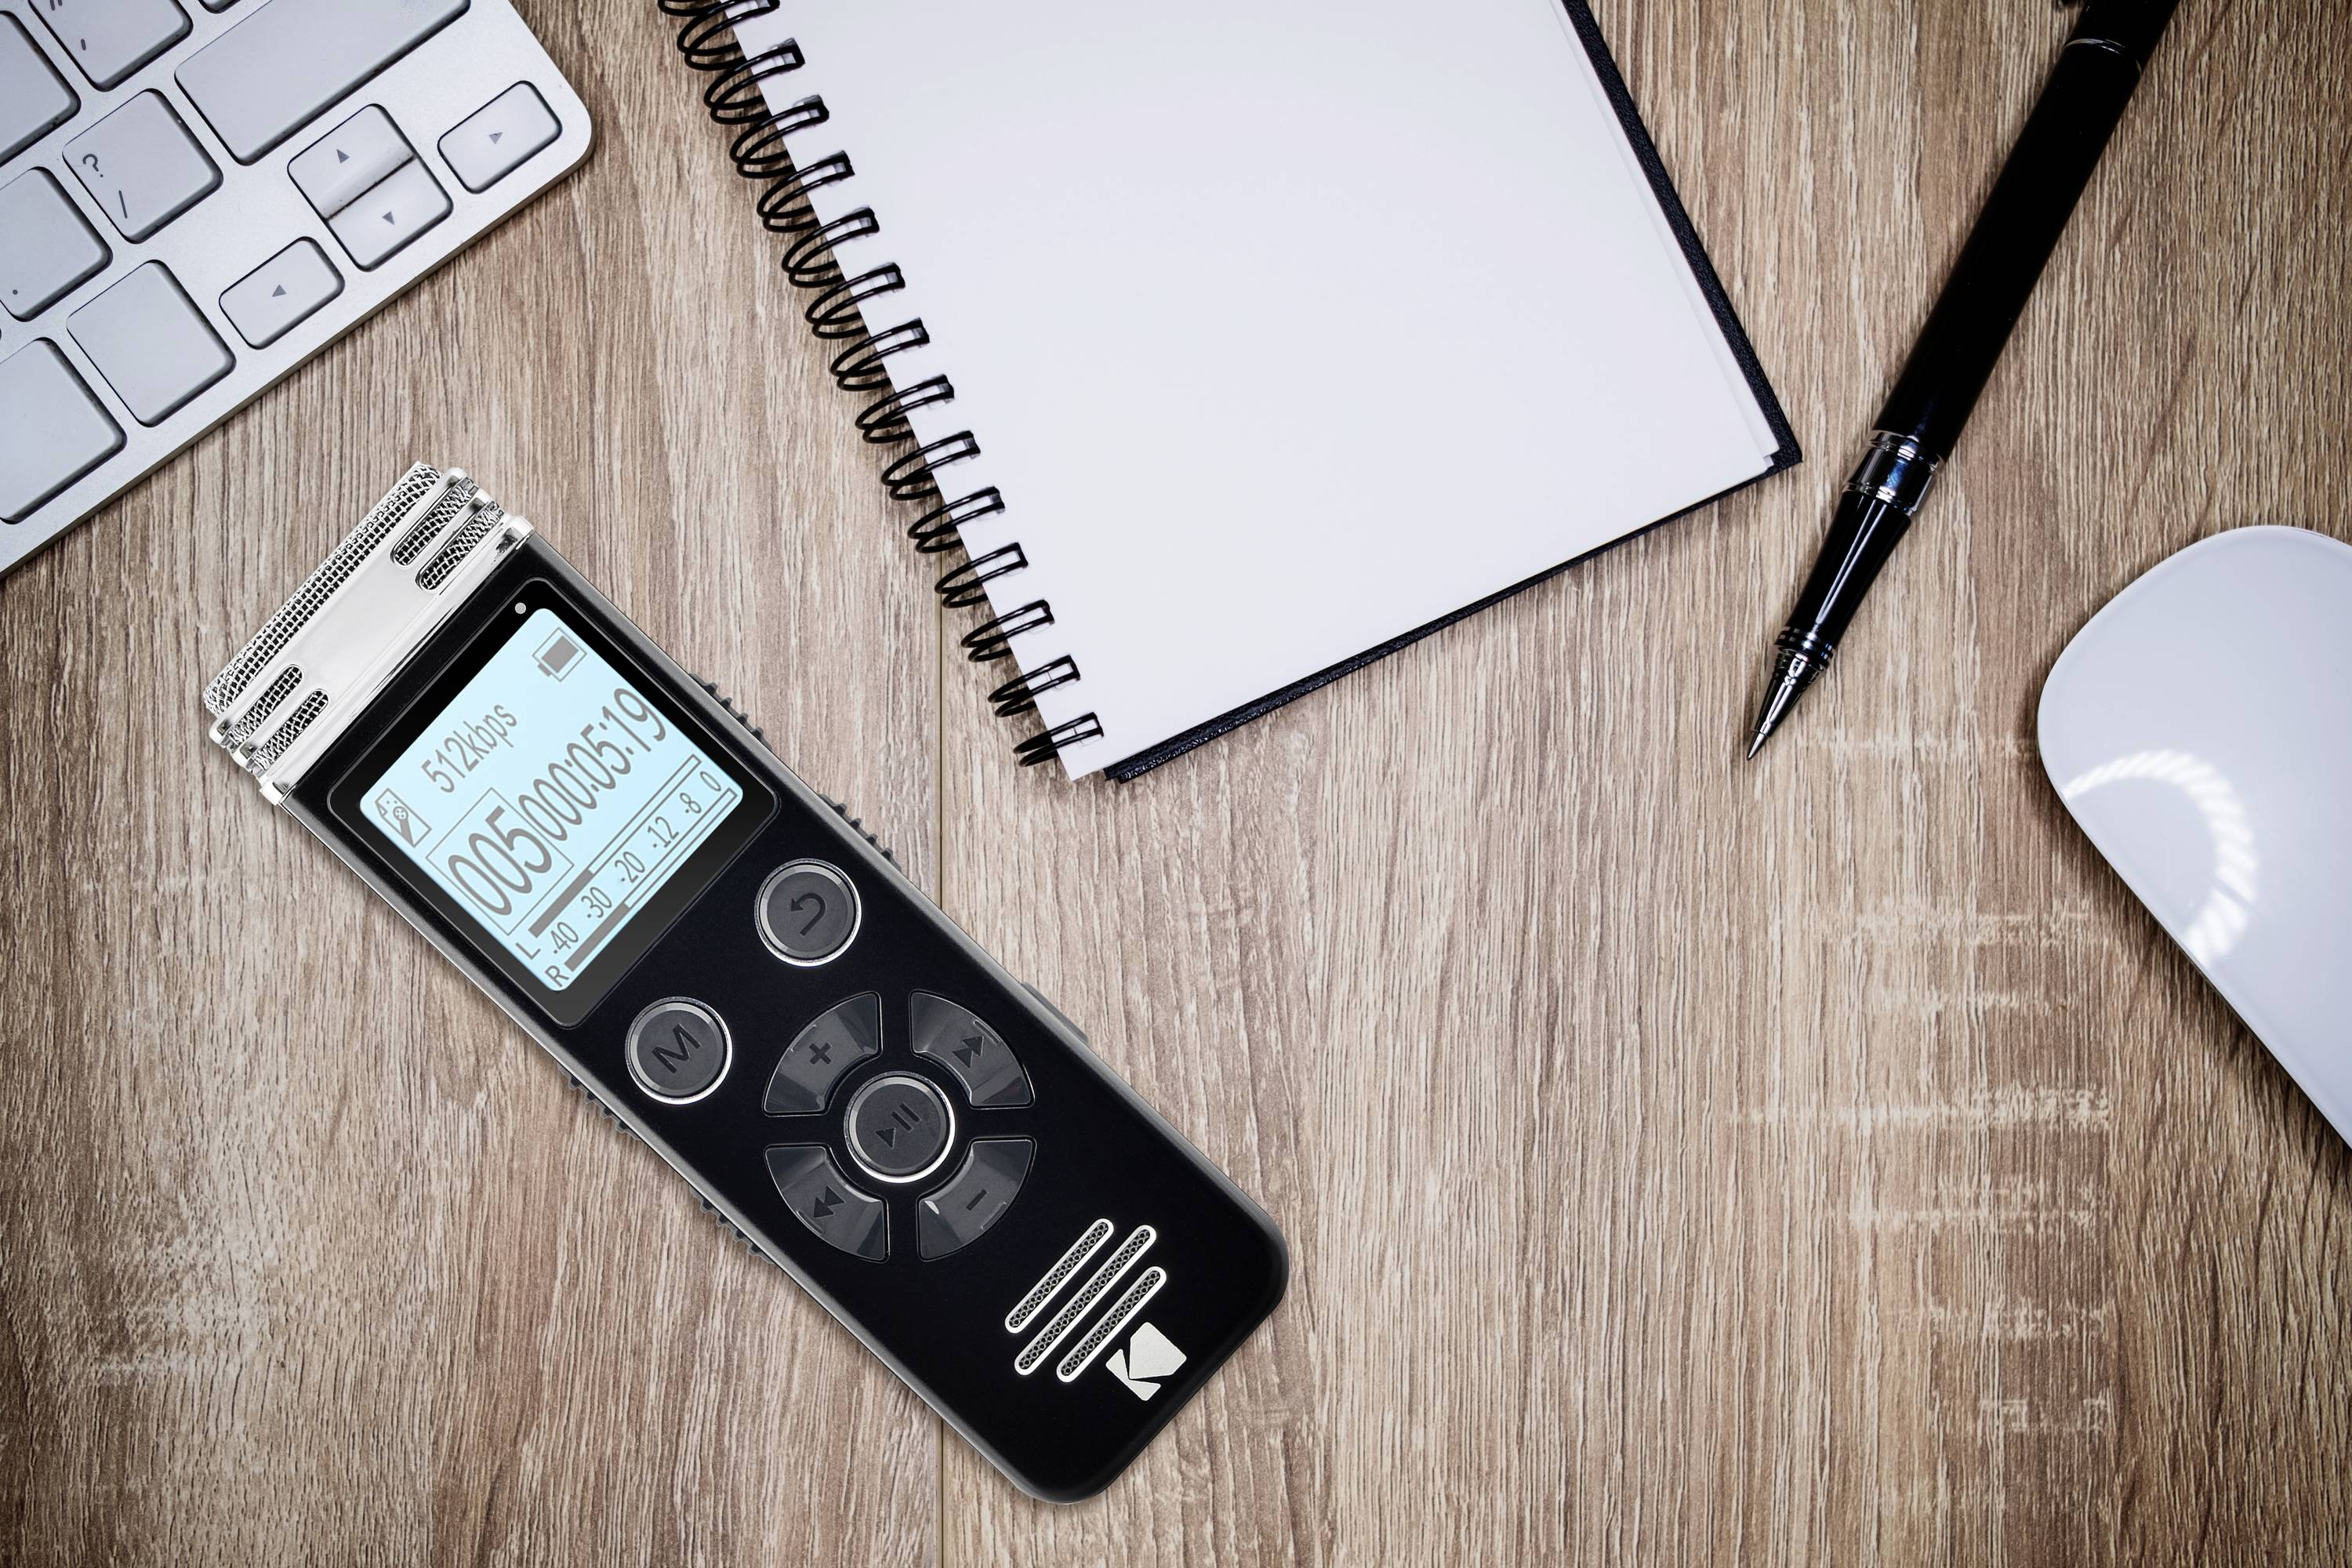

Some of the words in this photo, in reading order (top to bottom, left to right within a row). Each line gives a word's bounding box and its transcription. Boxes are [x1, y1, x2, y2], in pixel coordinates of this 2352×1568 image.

[82, 154, 103, 178] ?
[421, 704, 517, 793] 512kbps
[699, 771, 722, 793] 0
[448, 804, 553, 916] 005
[517, 688, 666, 841] 000:05:19
[515, 942, 541, 960] L
[544, 965, 570, 988] R
[652, 1022, 702, 1074] M
